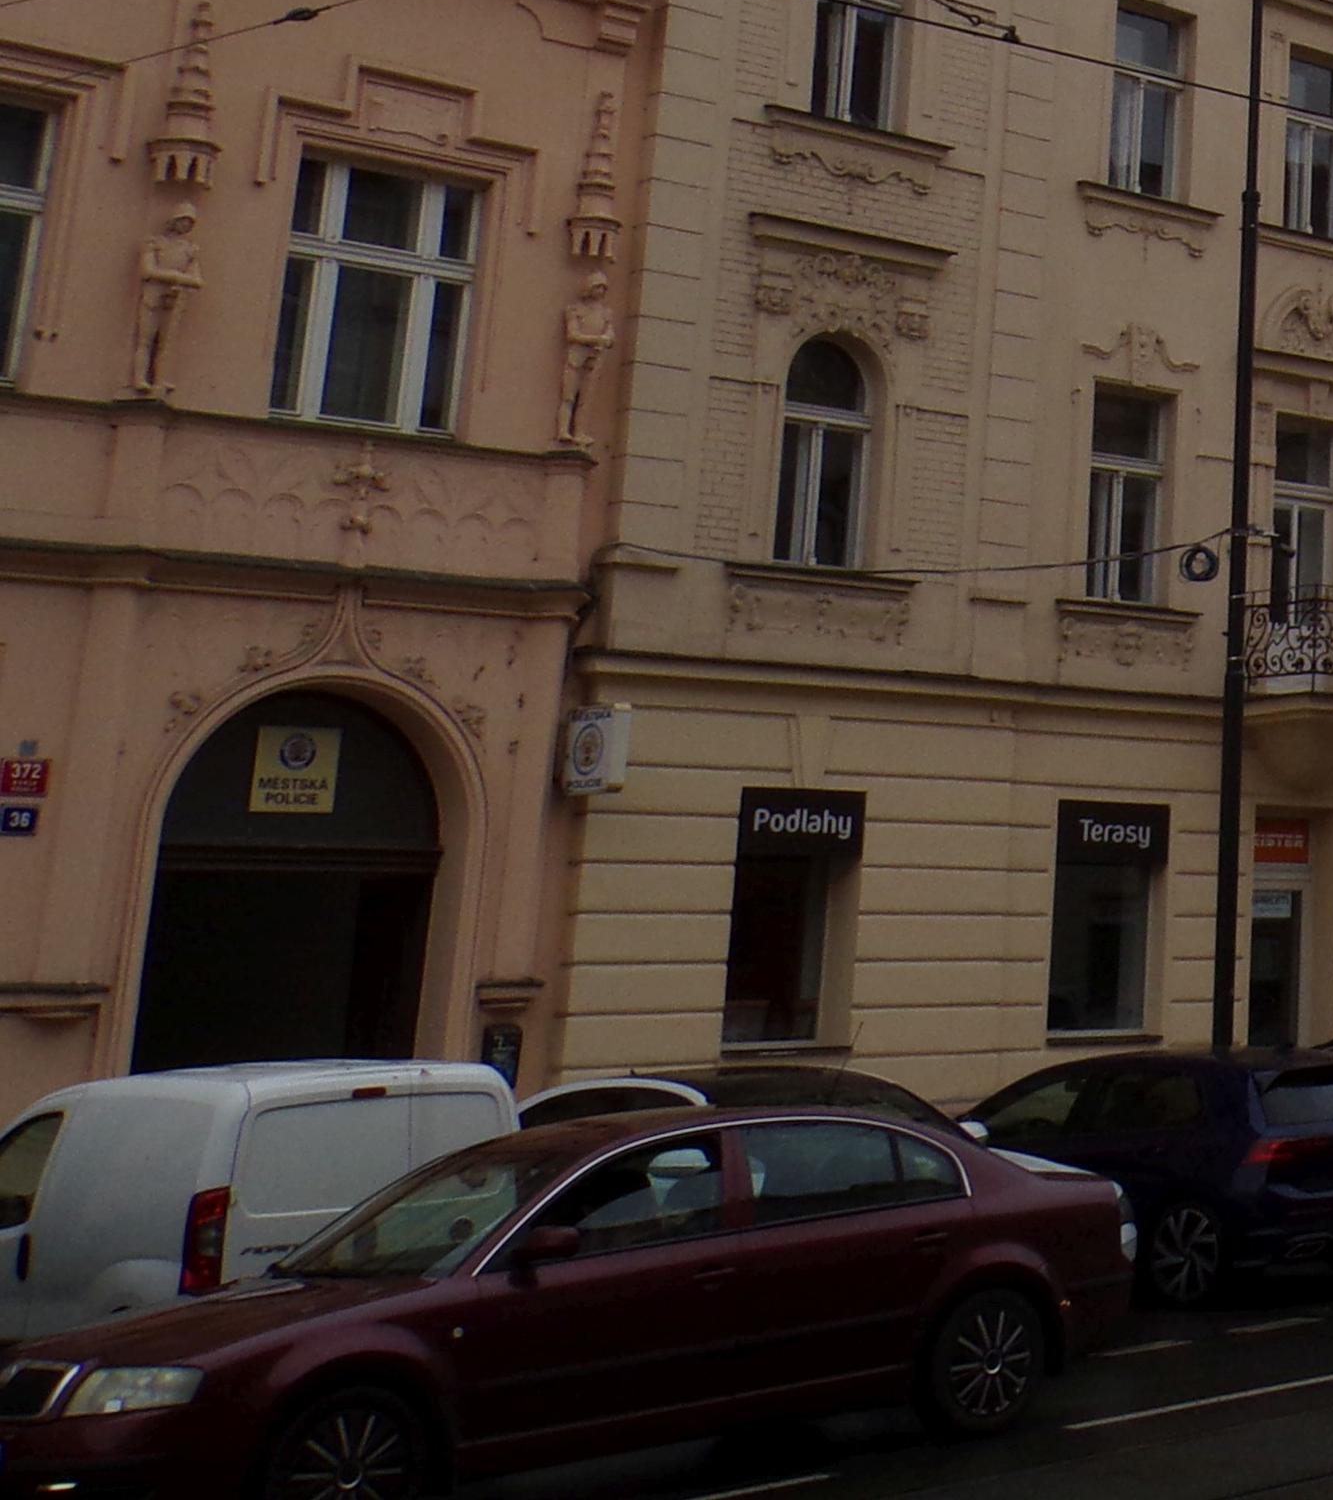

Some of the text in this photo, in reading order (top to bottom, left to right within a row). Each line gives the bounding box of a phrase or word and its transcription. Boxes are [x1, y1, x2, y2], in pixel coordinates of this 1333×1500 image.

[11, 763, 42, 779] 372
[265, 791, 319, 805] POLICIE
[8, 811, 31, 828] 36
[752, 807, 853, 841] Podlahy
[1079, 818, 1151, 849] Terasy
